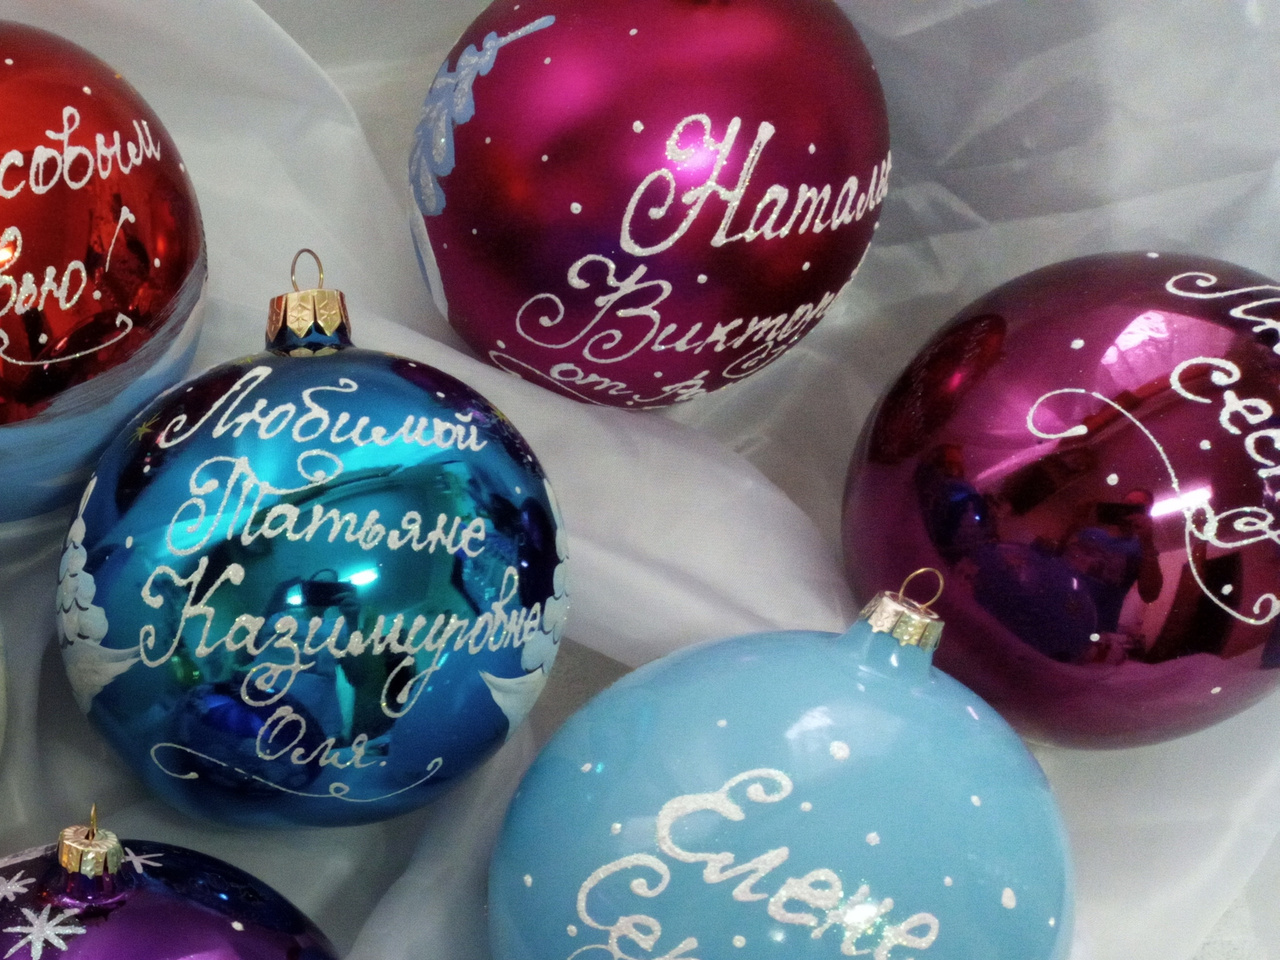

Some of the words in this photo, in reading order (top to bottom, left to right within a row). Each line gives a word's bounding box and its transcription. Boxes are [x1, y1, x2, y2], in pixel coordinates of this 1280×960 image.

[158, 365, 488, 452] Любимой
[165, 449, 488, 559] Татьяне
[139, 555, 548, 719] Казимировне
